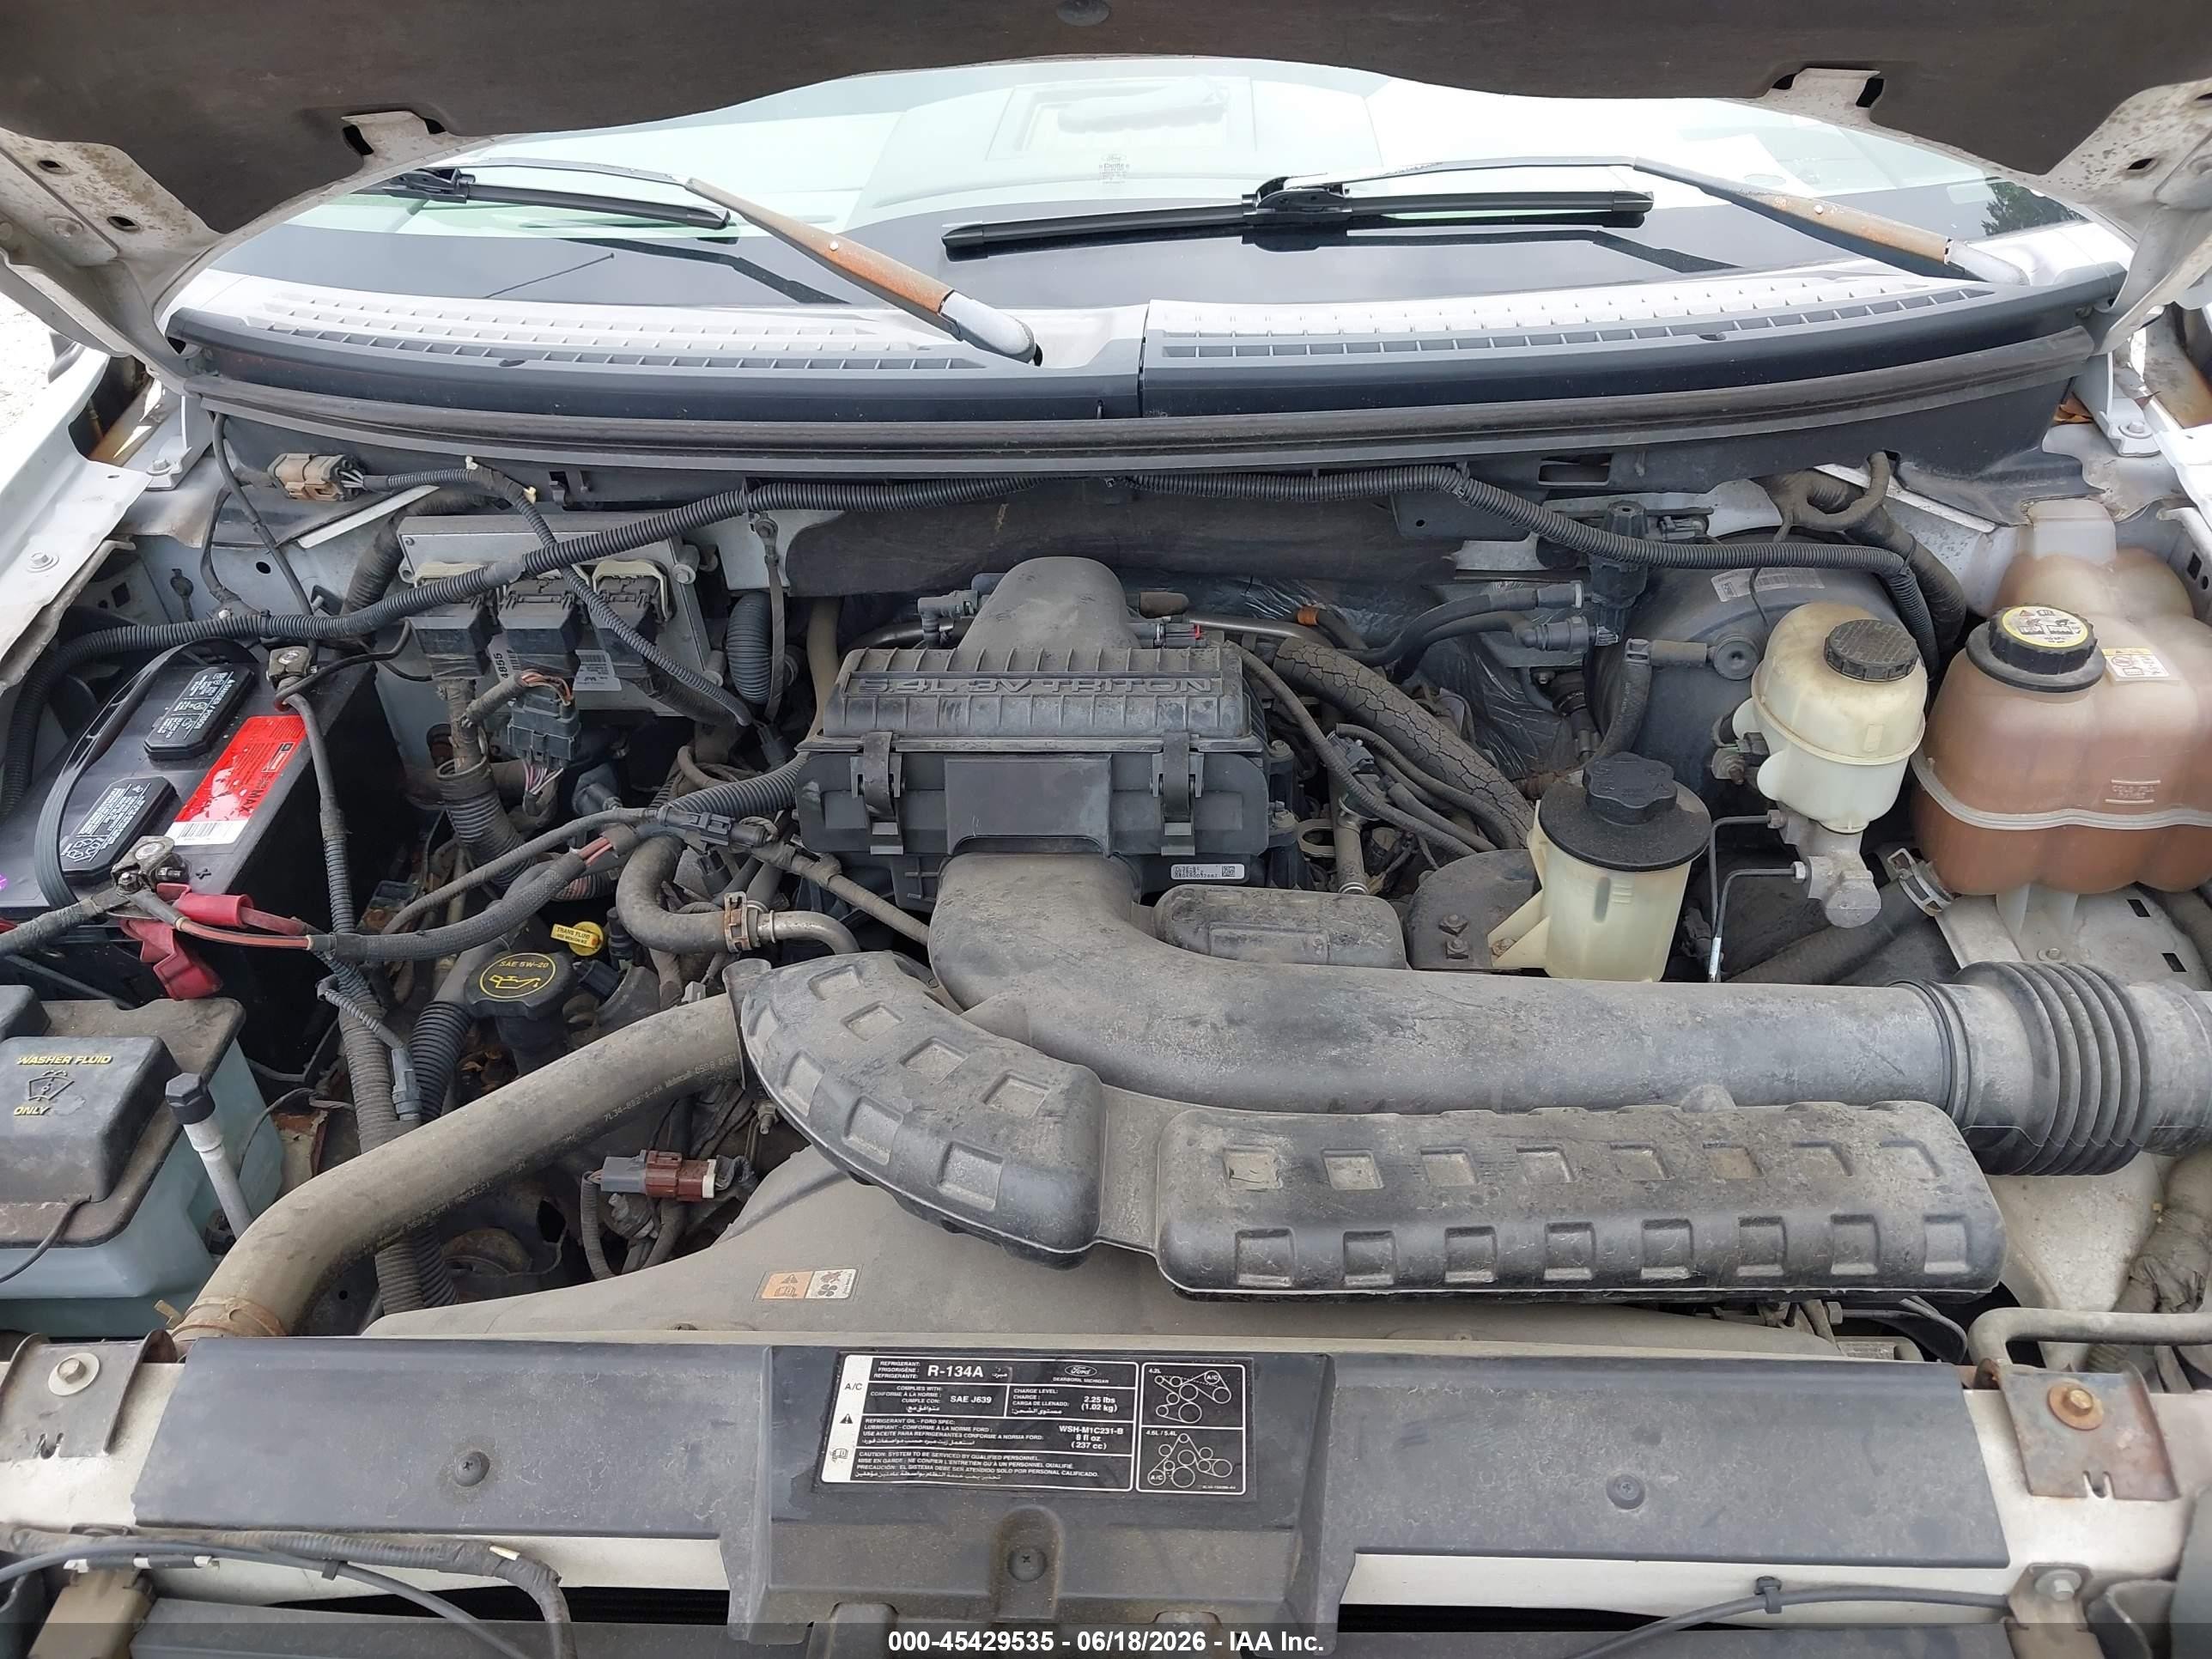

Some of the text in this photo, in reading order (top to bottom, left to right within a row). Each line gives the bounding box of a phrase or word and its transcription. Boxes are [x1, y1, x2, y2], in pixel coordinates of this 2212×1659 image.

[969, 678, 1030, 693] 3V
[1042, 678, 1211, 693] TRITON
[240, 789, 264, 812] MAX
[17, 1054, 112, 1065] WASHER FLUID
[14, 1106, 51, 1115] ONLY
[927, 1365, 984, 1377] R-134A
[845, 1382, 863, 1391] A/C
[1103, 1404, 1117, 1413] kg)
